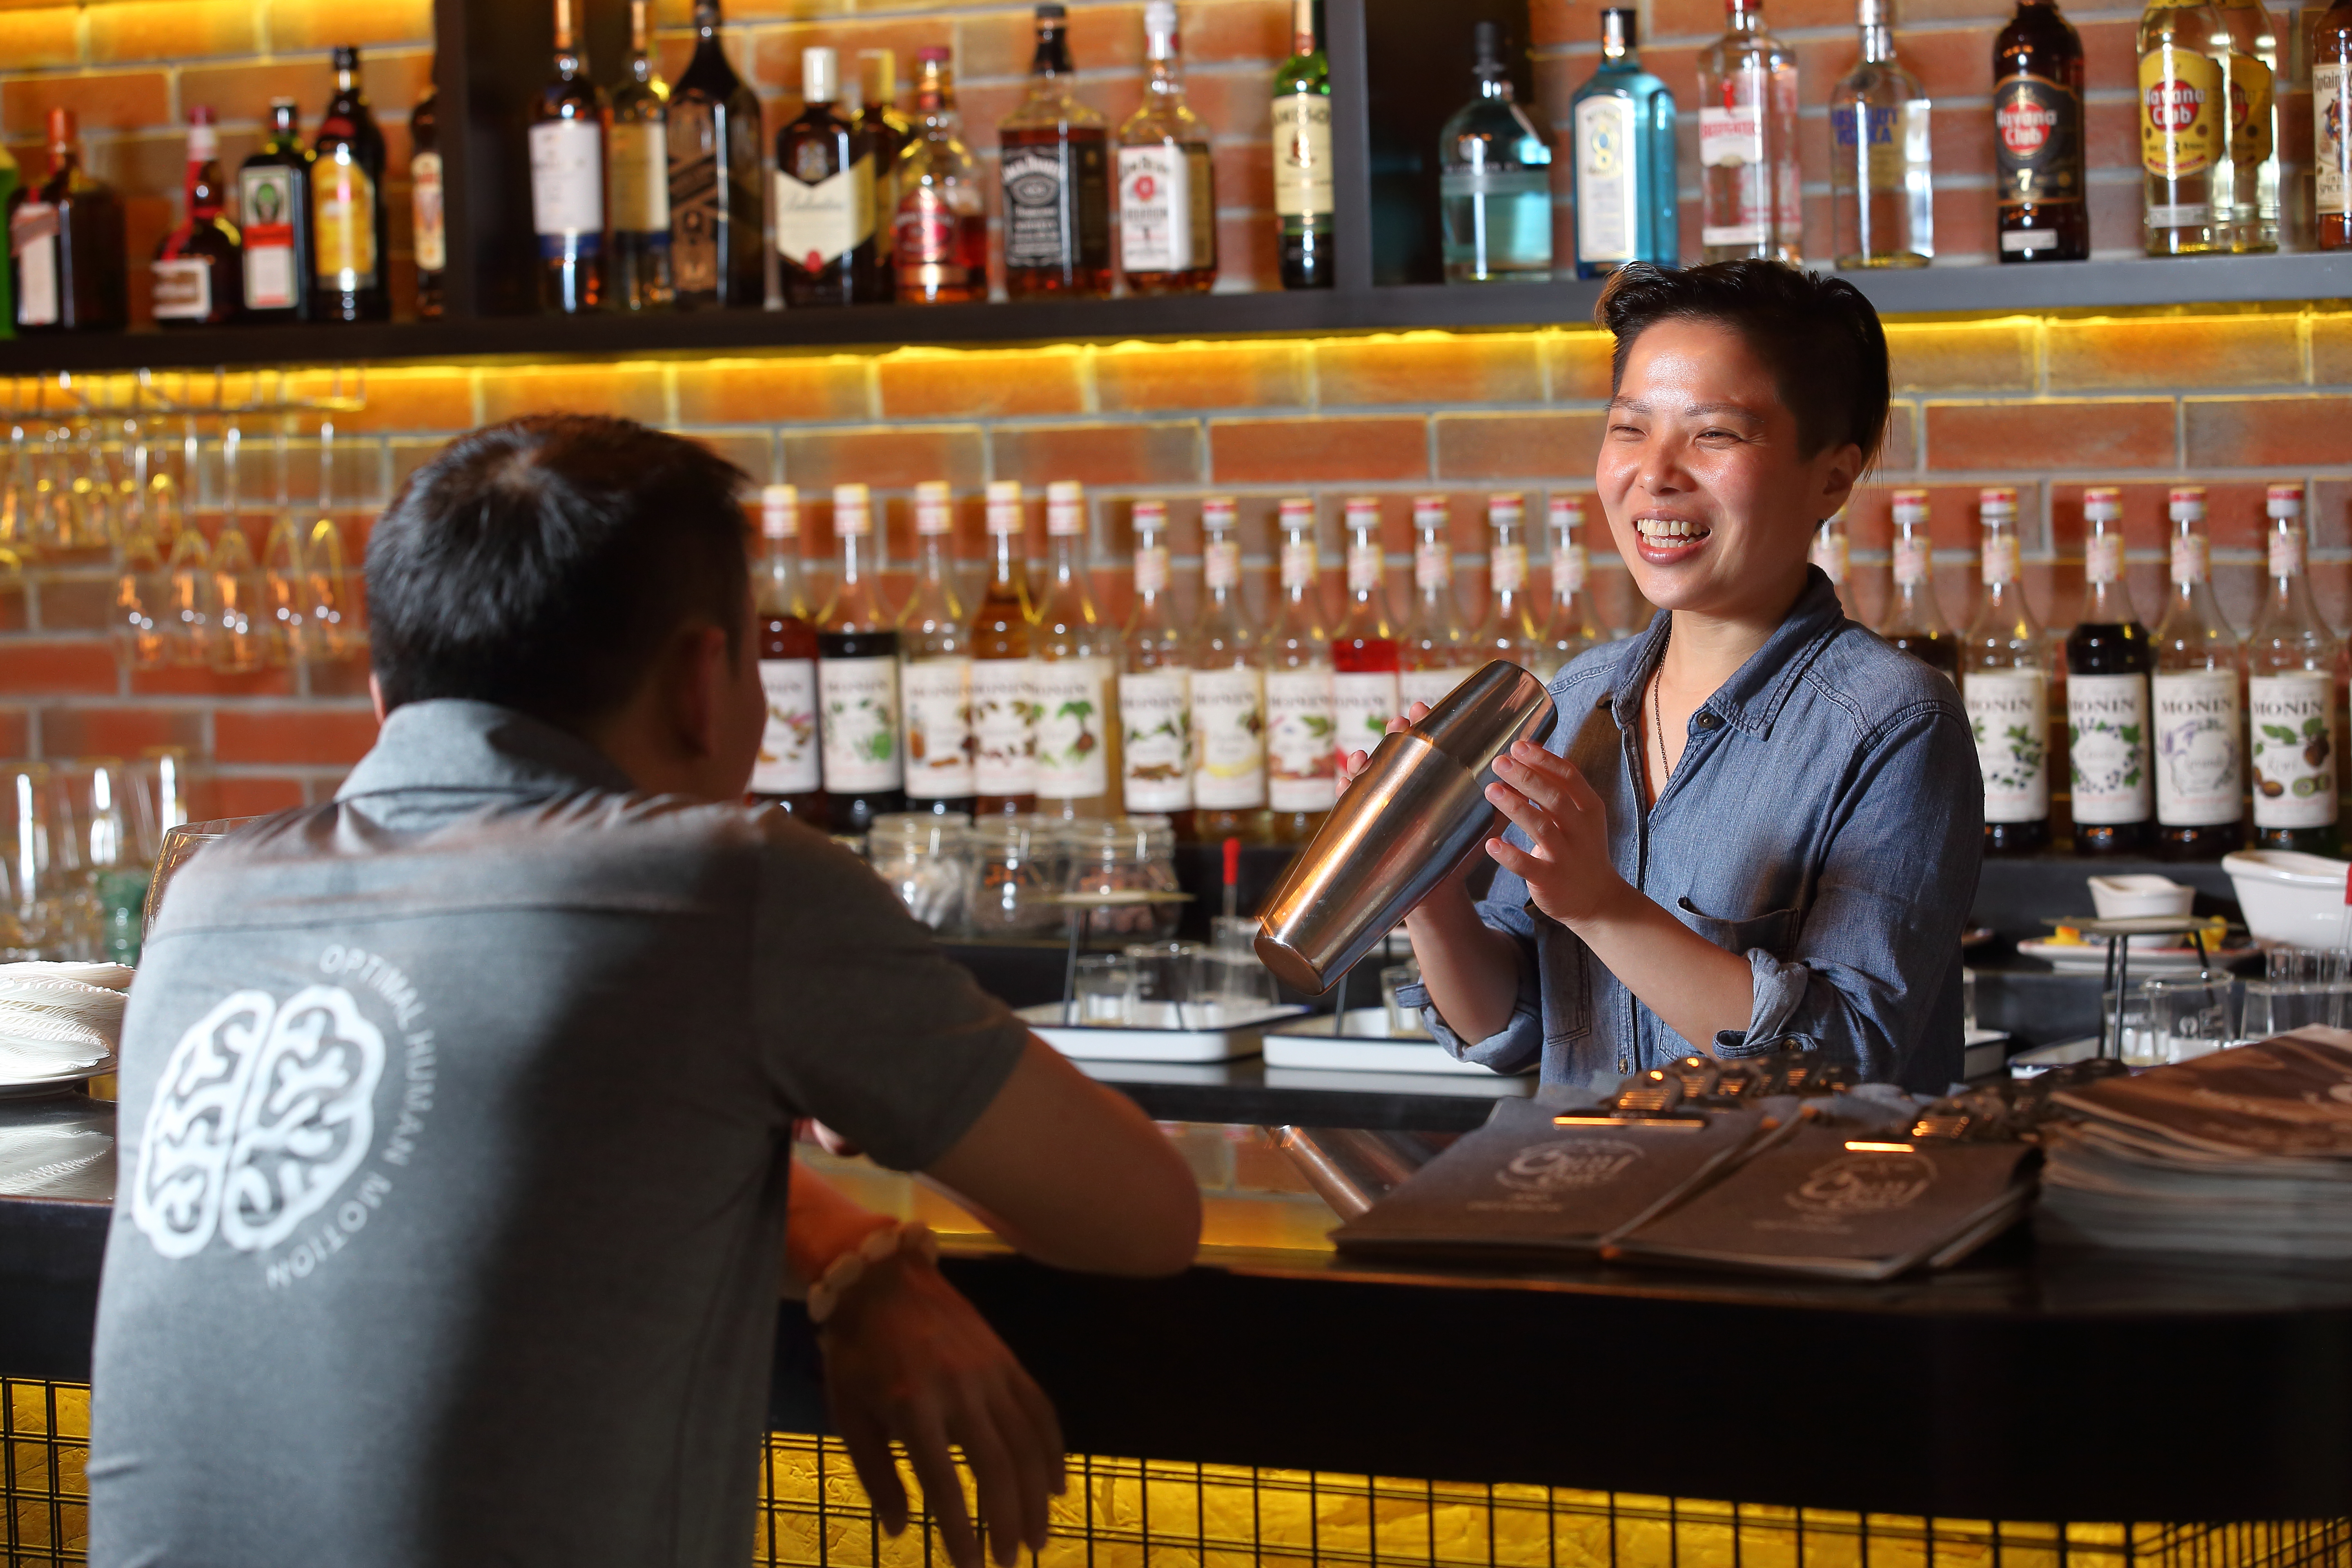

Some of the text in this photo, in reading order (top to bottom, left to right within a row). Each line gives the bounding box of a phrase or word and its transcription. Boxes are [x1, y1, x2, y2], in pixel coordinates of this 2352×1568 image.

[1832, 108, 1898, 126] ABSLUT
[1996, 109, 2058, 128] Havana
[1837, 126, 1893, 146] VOKA
[2005, 126, 2044, 146] Club
[2017, 167, 2033, 192] 7
[2161, 697, 2232, 715] MONIN
[2253, 699, 2323, 716] MONIN
[265, 944, 437, 1291] OPTIMAL HUMAN MOTION
